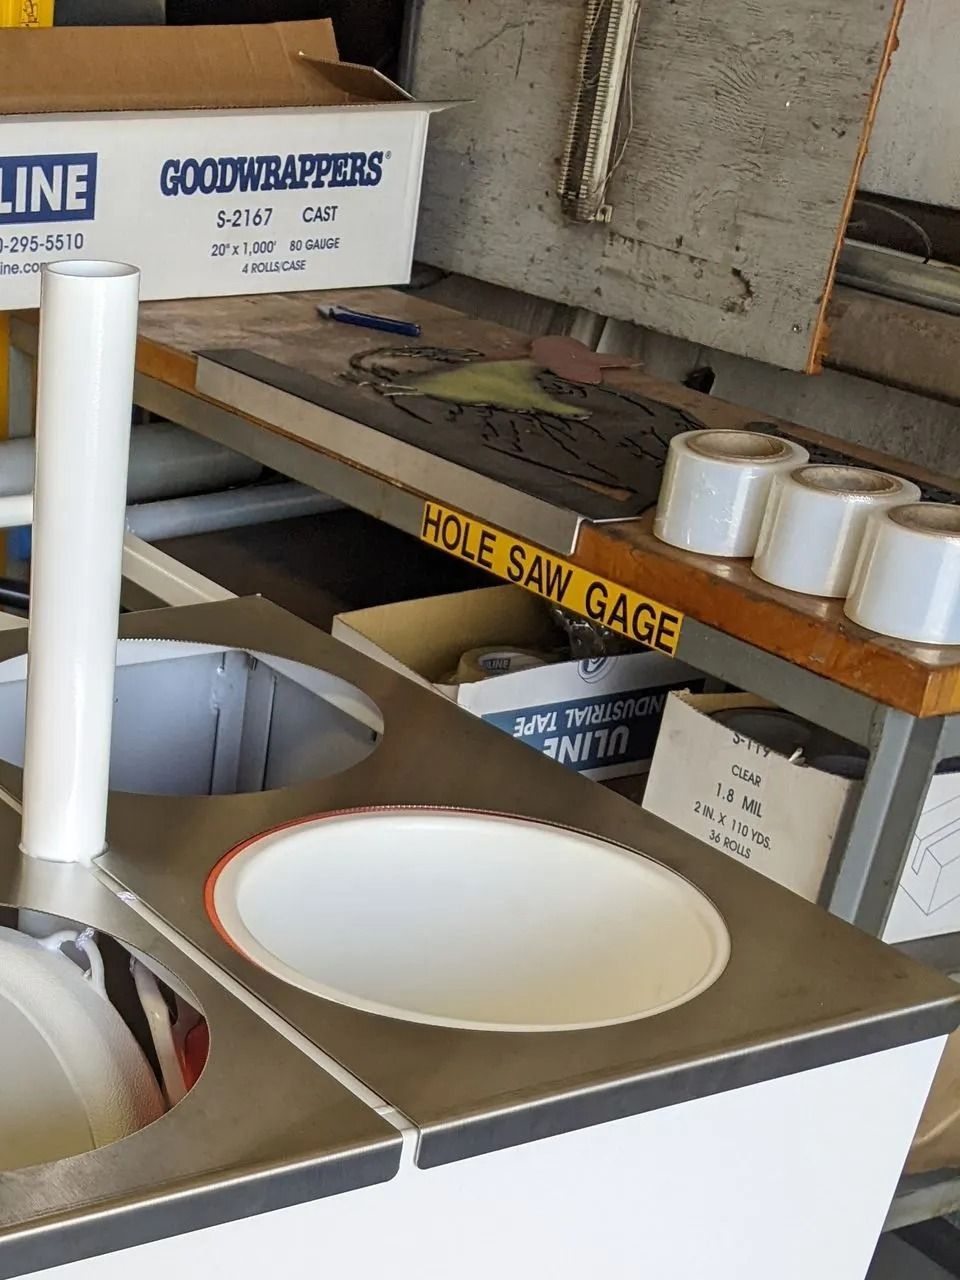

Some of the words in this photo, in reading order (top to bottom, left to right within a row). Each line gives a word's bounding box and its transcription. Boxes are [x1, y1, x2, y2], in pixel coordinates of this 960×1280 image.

[216, 208, 273, 228] S-2167
[302, 206, 338, 222] CAST
[290, 240, 302, 251] 80
[305, 237, 340, 251] GAUGE
[242, 263, 249, 274] 4
[422, 504, 497, 569] HOLE
[506, 544, 574, 603] SAW
[585, 581, 679, 654] GAGE
[513, 712, 558, 737] TAPE
[543, 725, 630, 764] ULINE
[731, 764, 762, 788] CLEAR
[716, 782, 735, 803] 1.8
[741, 795, 762, 818] MIL
[693, 801, 701, 813] 2
[702, 804, 715, 821] IN.
[717, 812, 727, 826] X
[731, 819, 749, 837] 110
[751, 829, 771, 850] YDS.
[709, 829, 721, 843] 36
[723, 836, 752, 859] ROLLS
